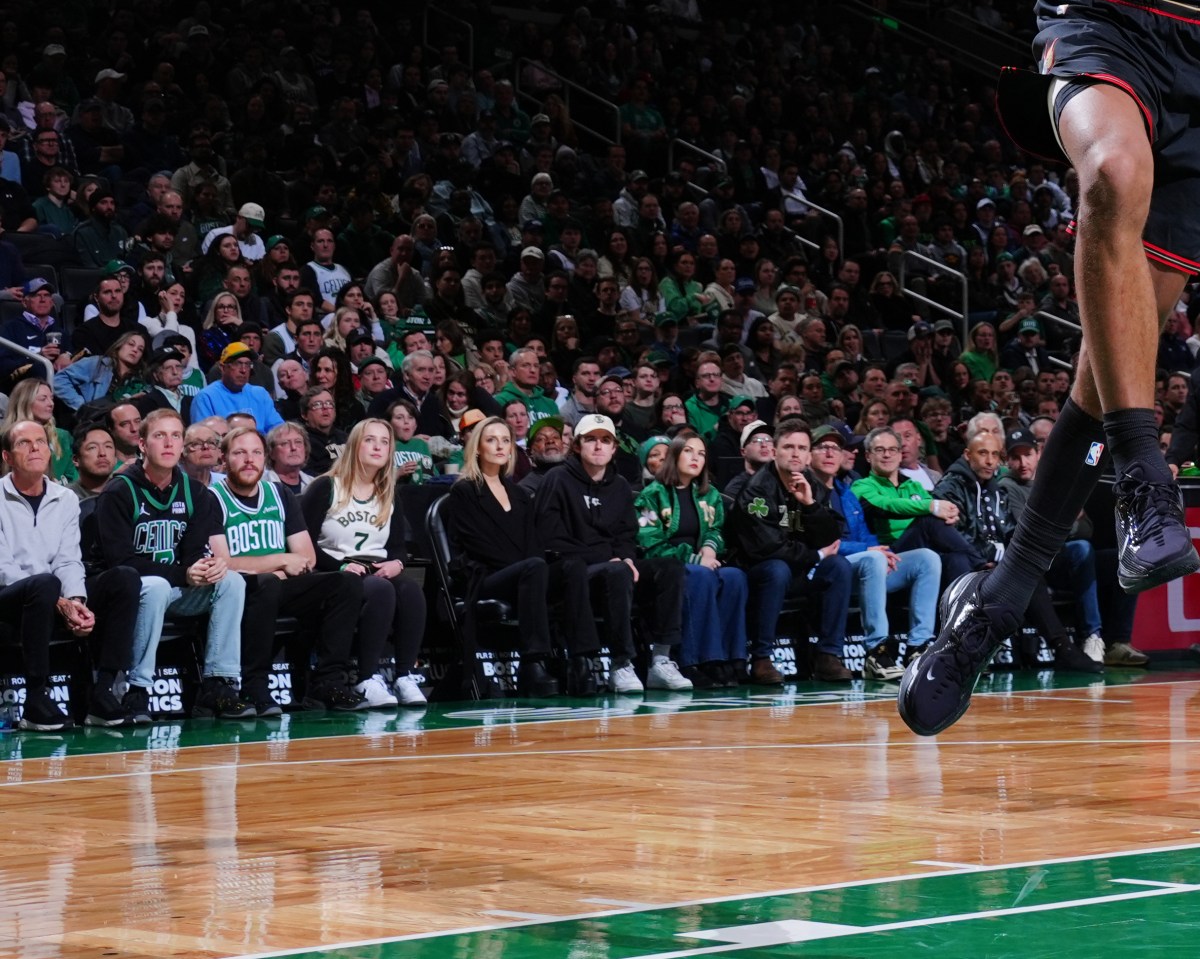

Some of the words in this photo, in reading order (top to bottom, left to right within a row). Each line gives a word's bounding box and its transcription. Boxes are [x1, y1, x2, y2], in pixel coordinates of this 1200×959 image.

[177, 384, 200, 396] STON
[394, 451, 424, 468] OSTON
[227, 519, 286, 557] BOSTON
[354, 531, 369, 551] 7
[272, 663, 289, 671] SEAT
